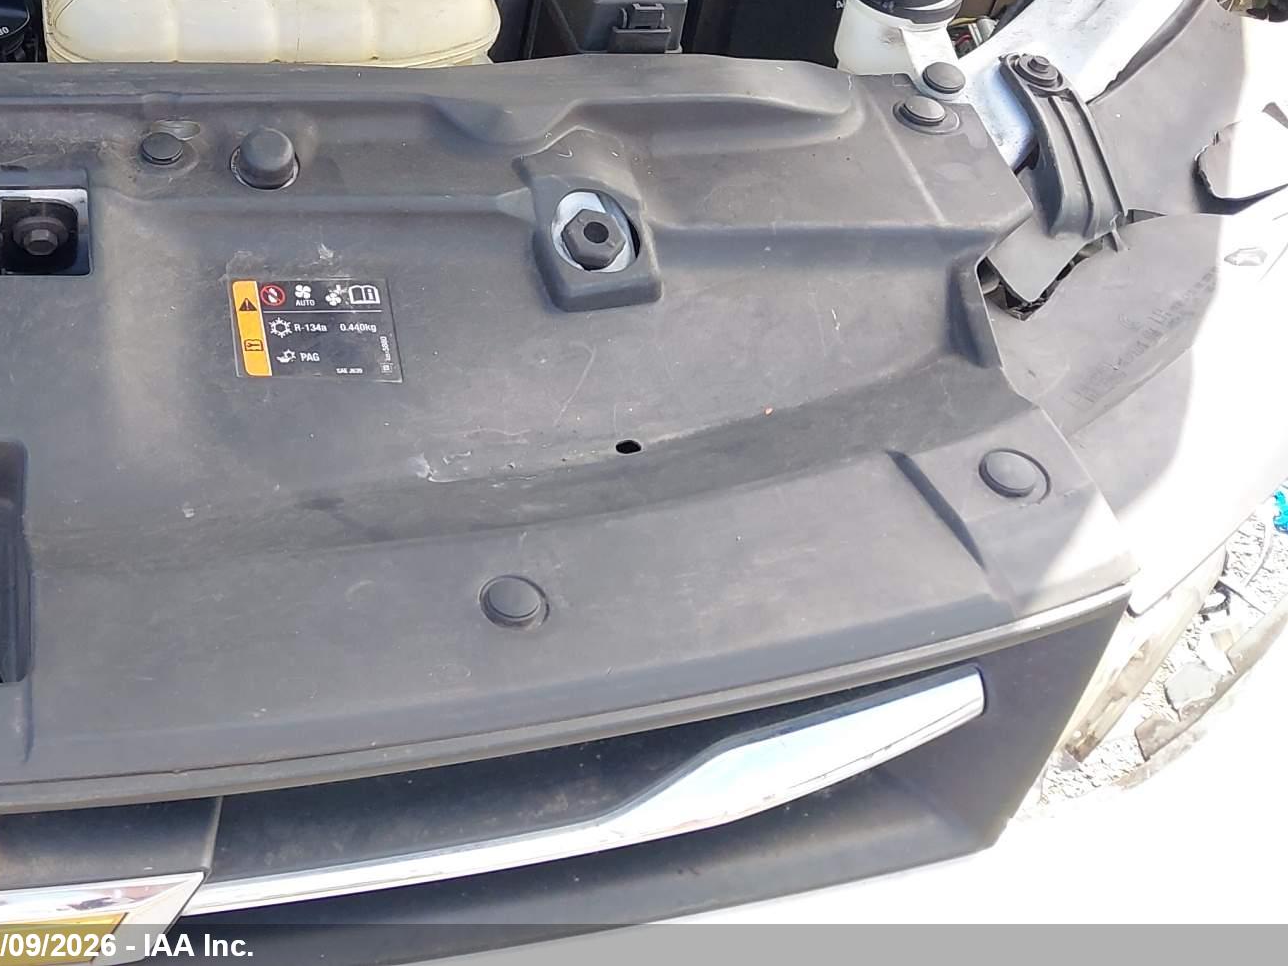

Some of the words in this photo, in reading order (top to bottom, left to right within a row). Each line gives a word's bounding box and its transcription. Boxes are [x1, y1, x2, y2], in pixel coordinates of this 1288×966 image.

[295, 299, 316, 307] AUTO
[293, 323, 328, 332] R-134a
[339, 323, 377, 333] 0.440kg
[300, 352, 320, 362] PAG
